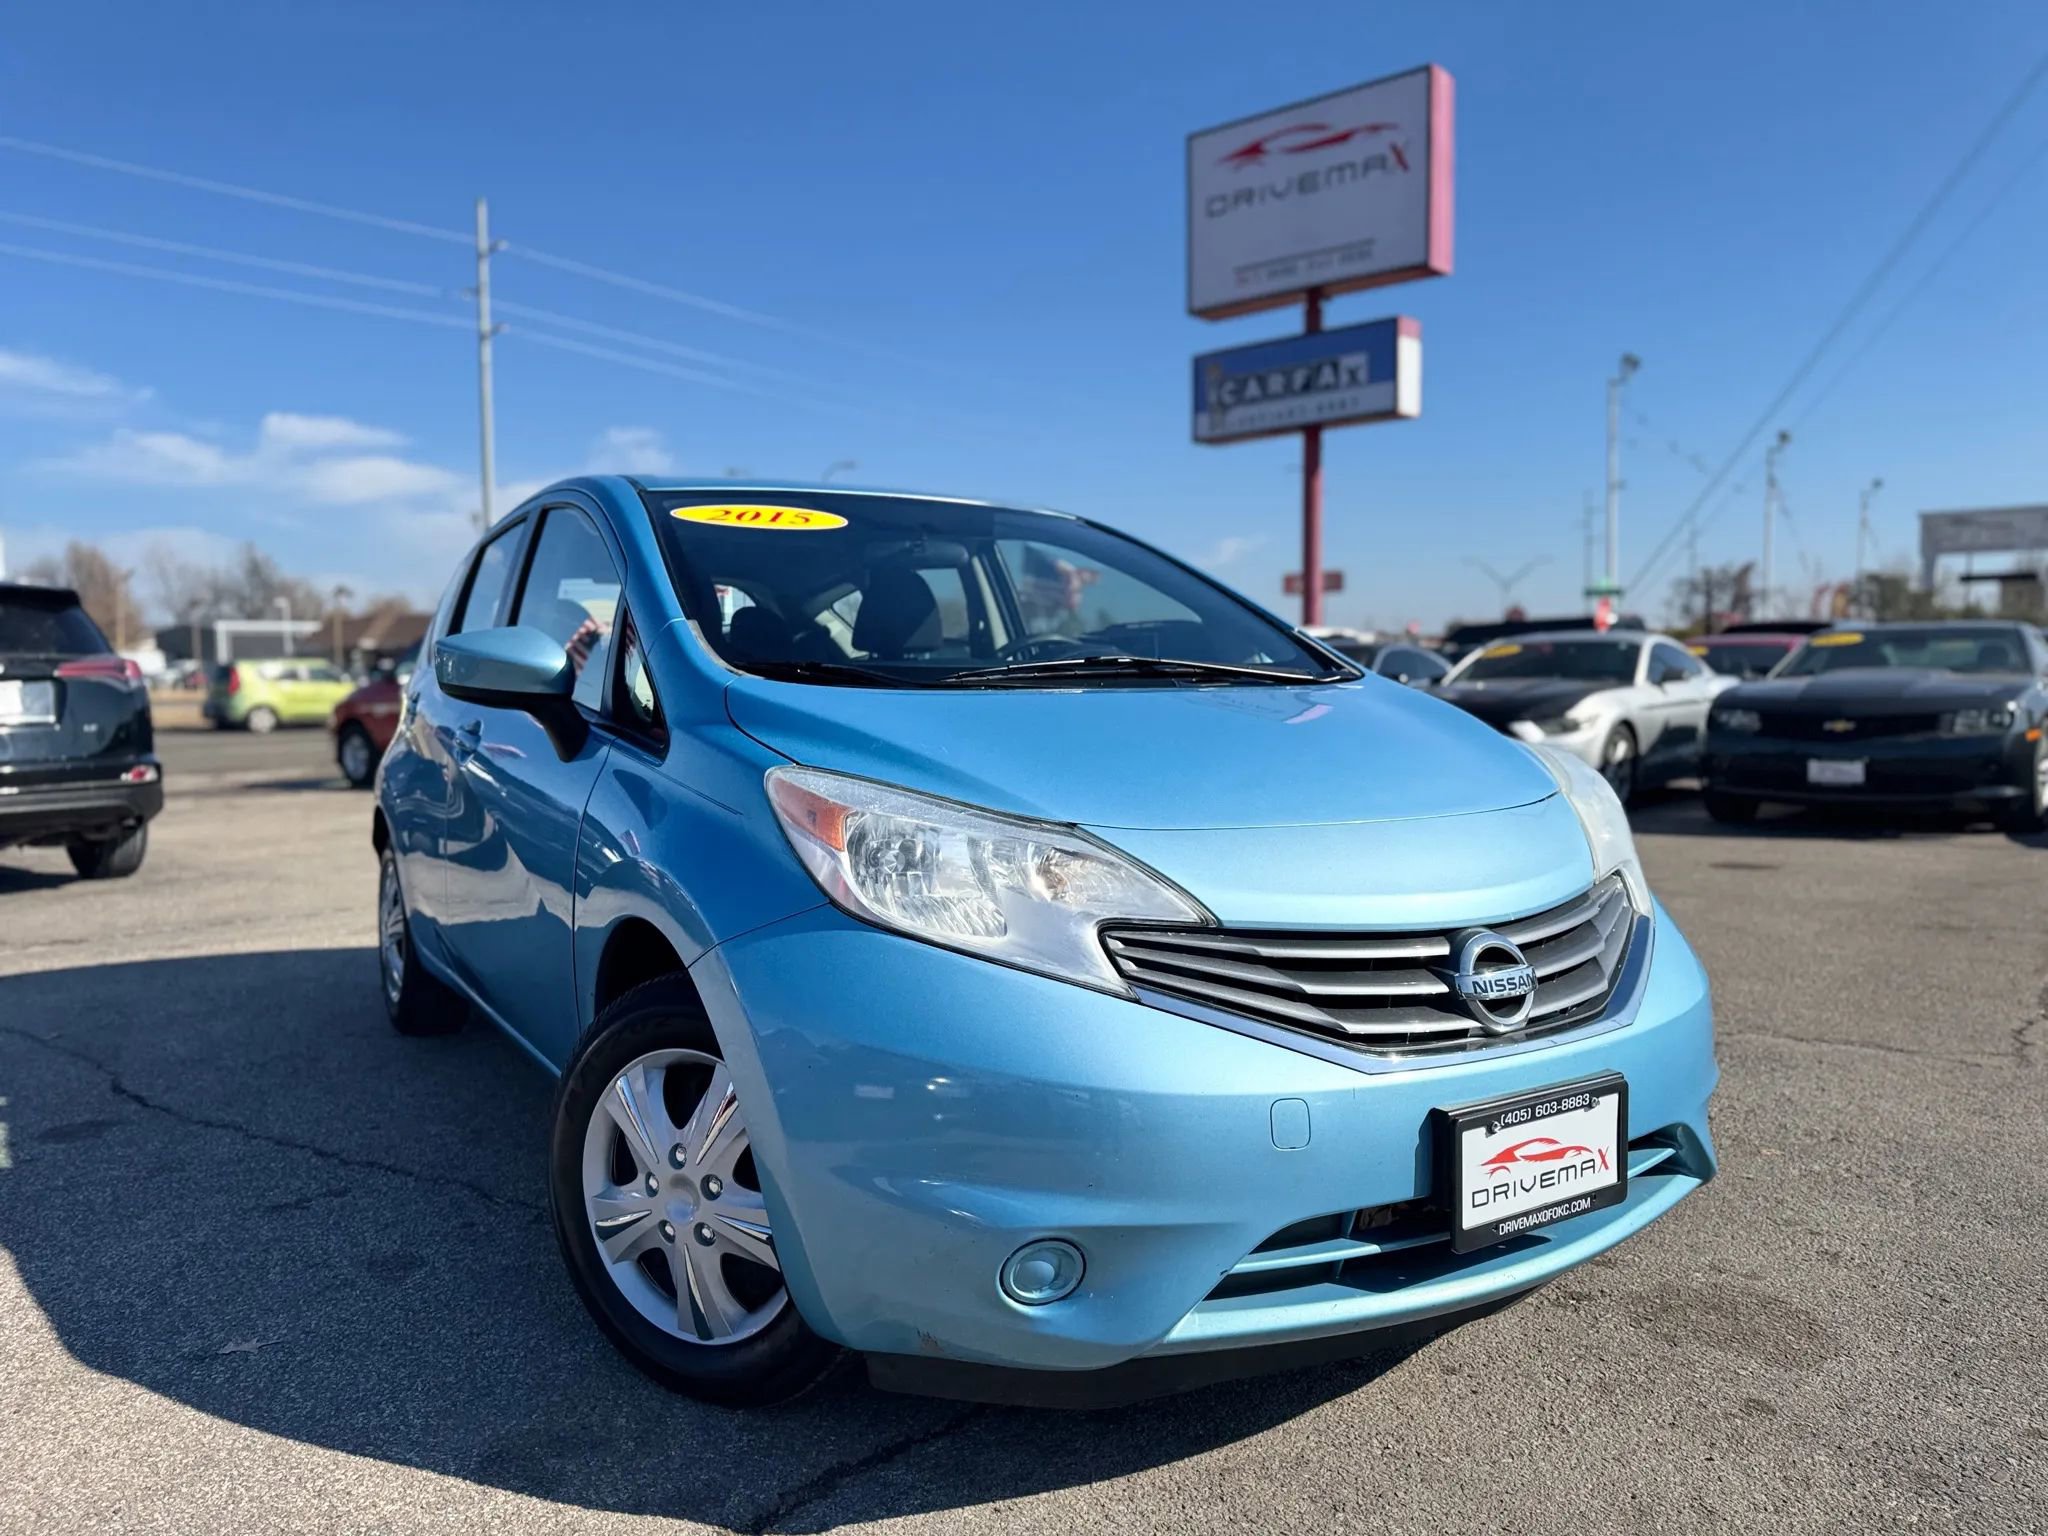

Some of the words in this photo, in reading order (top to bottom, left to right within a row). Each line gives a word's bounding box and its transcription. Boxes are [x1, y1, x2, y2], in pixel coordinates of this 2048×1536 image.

[1205, 137, 1410, 219] DRIVEMAX
[706, 509, 814, 524] 2015
[1472, 967, 1537, 995] NISSAN
[1501, 1107, 1531, 1126] (405)
[1535, 1094, 1590, 1118] 603-8883
[1471, 1145, 1609, 1208] DRIVEMAX
[1499, 1197, 1591, 1236] DRIVEMAXOFOKC.COM
